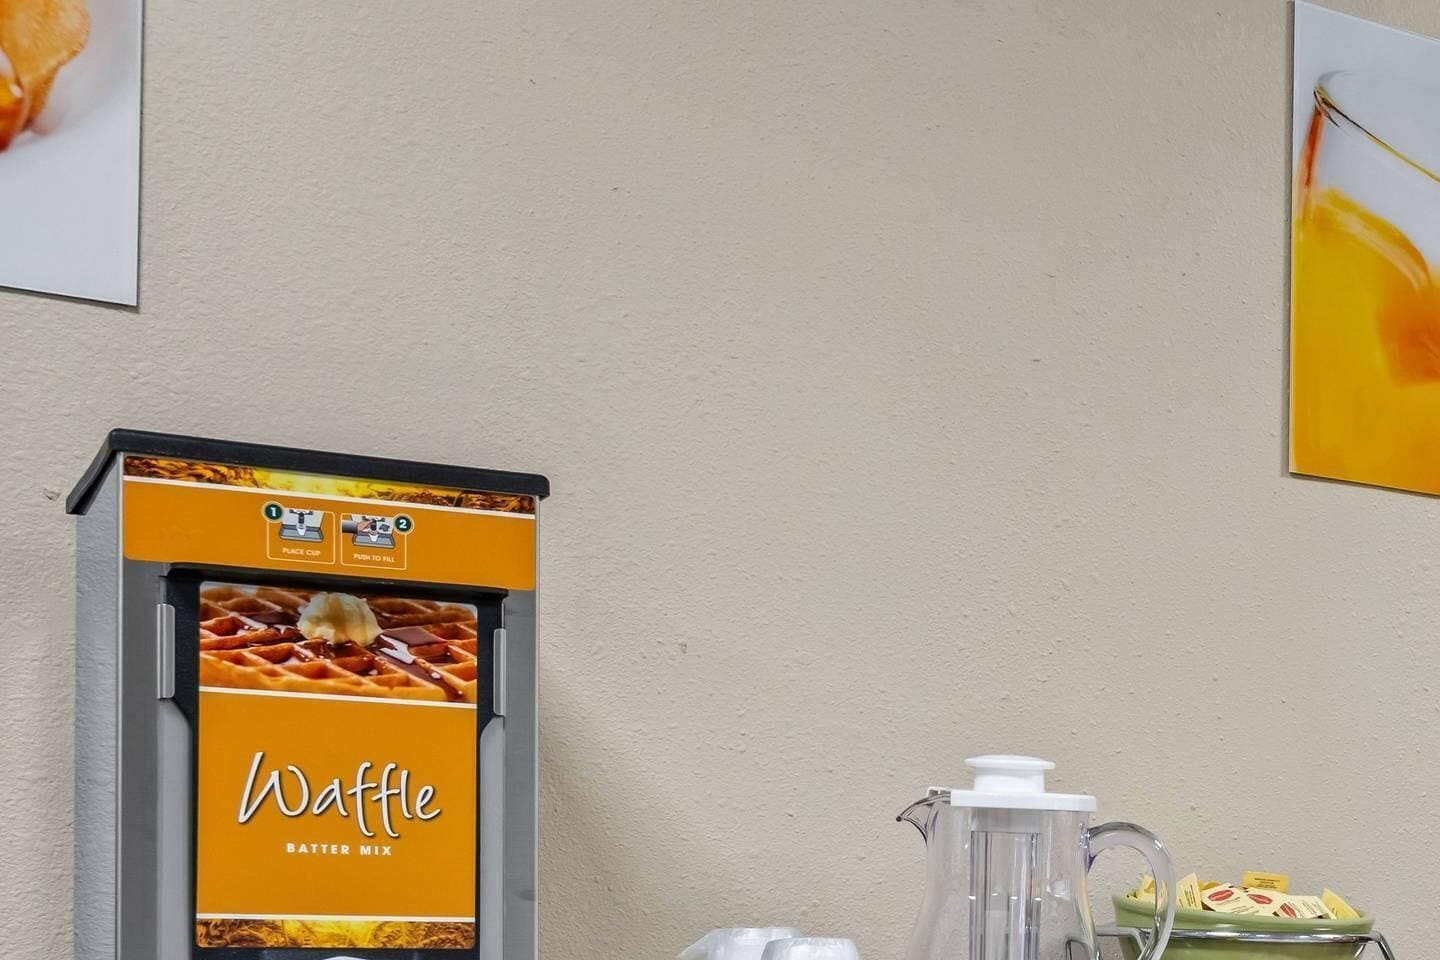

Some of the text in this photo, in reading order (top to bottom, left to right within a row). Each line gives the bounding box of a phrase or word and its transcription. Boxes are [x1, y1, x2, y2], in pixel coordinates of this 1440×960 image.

[270, 507, 277, 517] 1
[400, 519, 408, 529] 2
[282, 547, 320, 557] PLACE CUP
[353, 553, 371, 561] PUSH
[383, 556, 396, 564] FILL
[237, 751, 441, 838] Waffle
[286, 843, 392, 856] BATTER MIX
